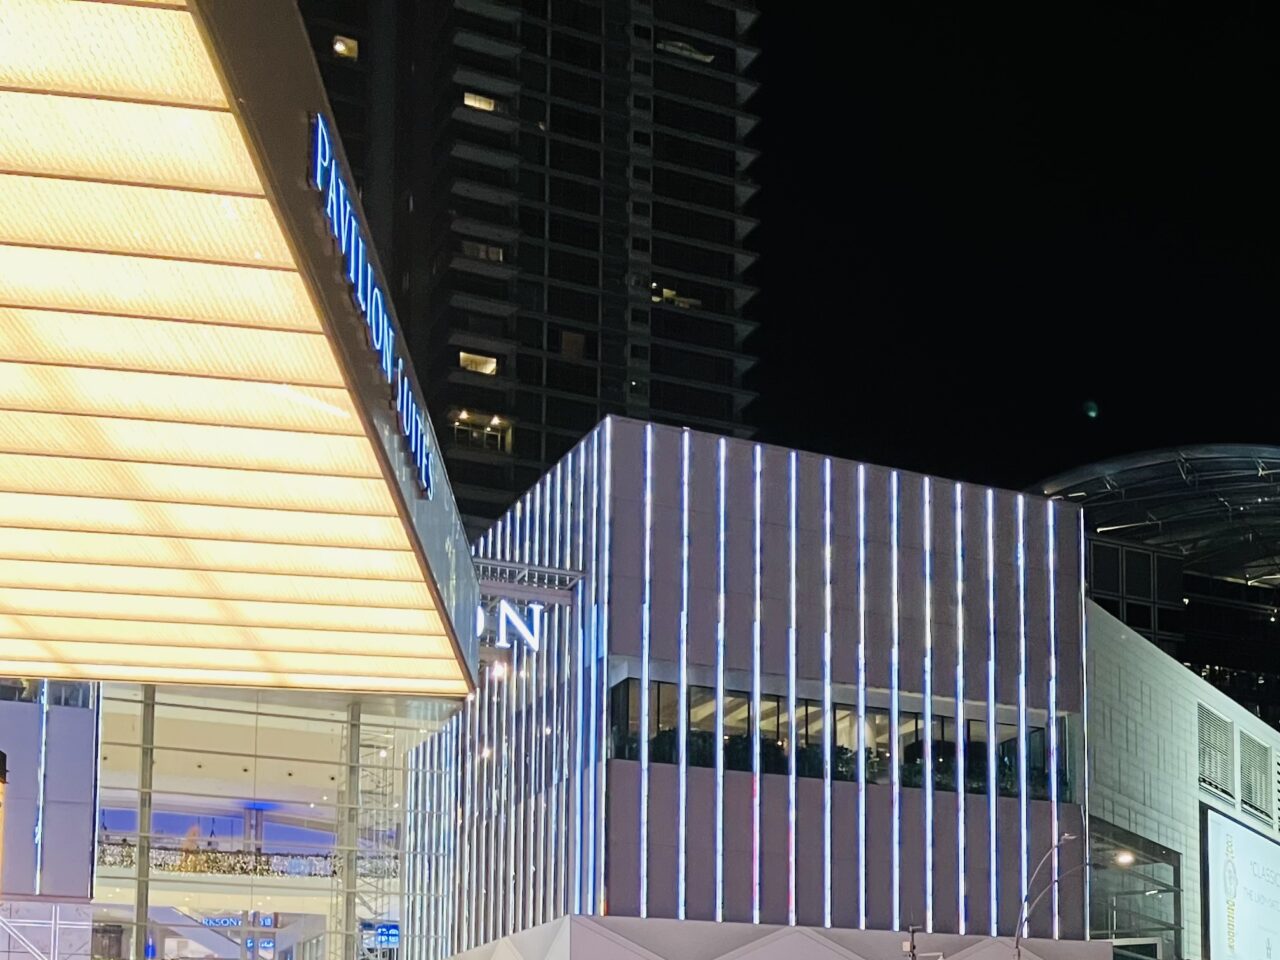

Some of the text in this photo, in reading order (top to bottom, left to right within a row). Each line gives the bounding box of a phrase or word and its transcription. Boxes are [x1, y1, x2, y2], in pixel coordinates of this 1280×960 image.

[314, 113, 434, 501] PAVILION SUITES
[202, 917, 237, 927] RKSON
